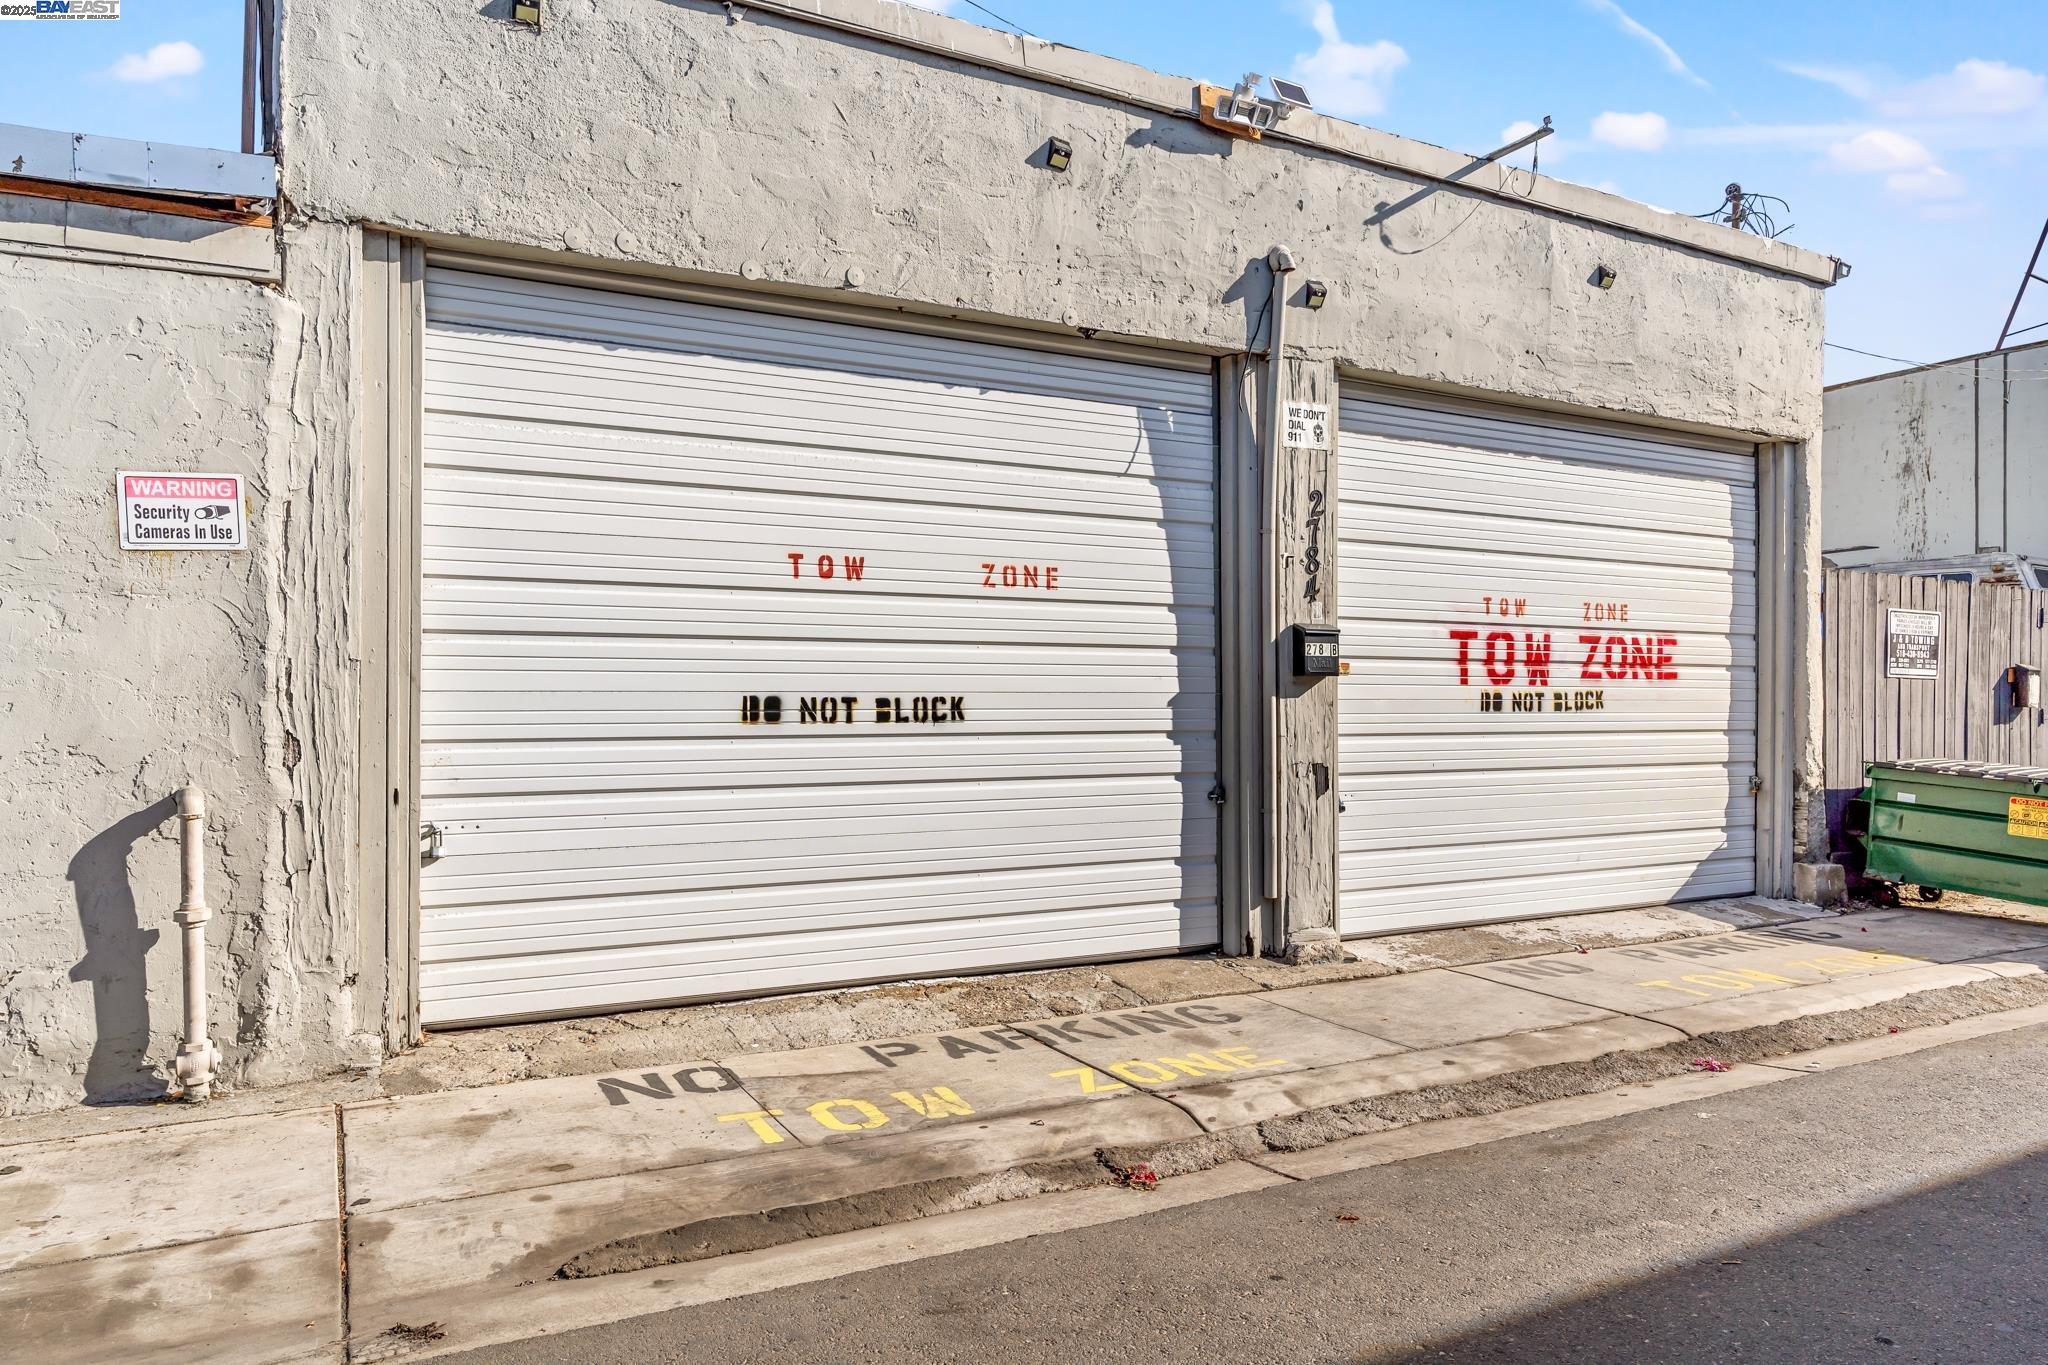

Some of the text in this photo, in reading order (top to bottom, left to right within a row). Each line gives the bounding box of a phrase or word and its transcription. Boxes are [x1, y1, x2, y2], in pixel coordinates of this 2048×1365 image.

[1288, 407, 1326, 421] WE DON'T
[1288, 419, 1306, 431] DIAL
[1288, 431, 1302, 442] 911
[130, 479, 233, 497] WARNING
[134, 503, 190, 523] Security
[135, 523, 233, 540] Cameras In Use
[1303, 489, 1325, 605] 2784
[787, 553, 1059, 591] TOW ZONE
[1483, 597, 1629, 622] TOW ZONE
[1306, 643, 1337, 656] 278 B
[1911, 636, 1935, 645] TOWING
[1449, 630, 1678, 686] TOW ZONE
[741, 695, 966, 724] DO NOT BLOCK
[1480, 691, 1605, 713] DO NOT BLOCK
[1487, 959, 1595, 981] NO
[596, 1005, 1243, 1106] NO PARKING
[716, 1044, 1288, 1144] TOW ZONE
